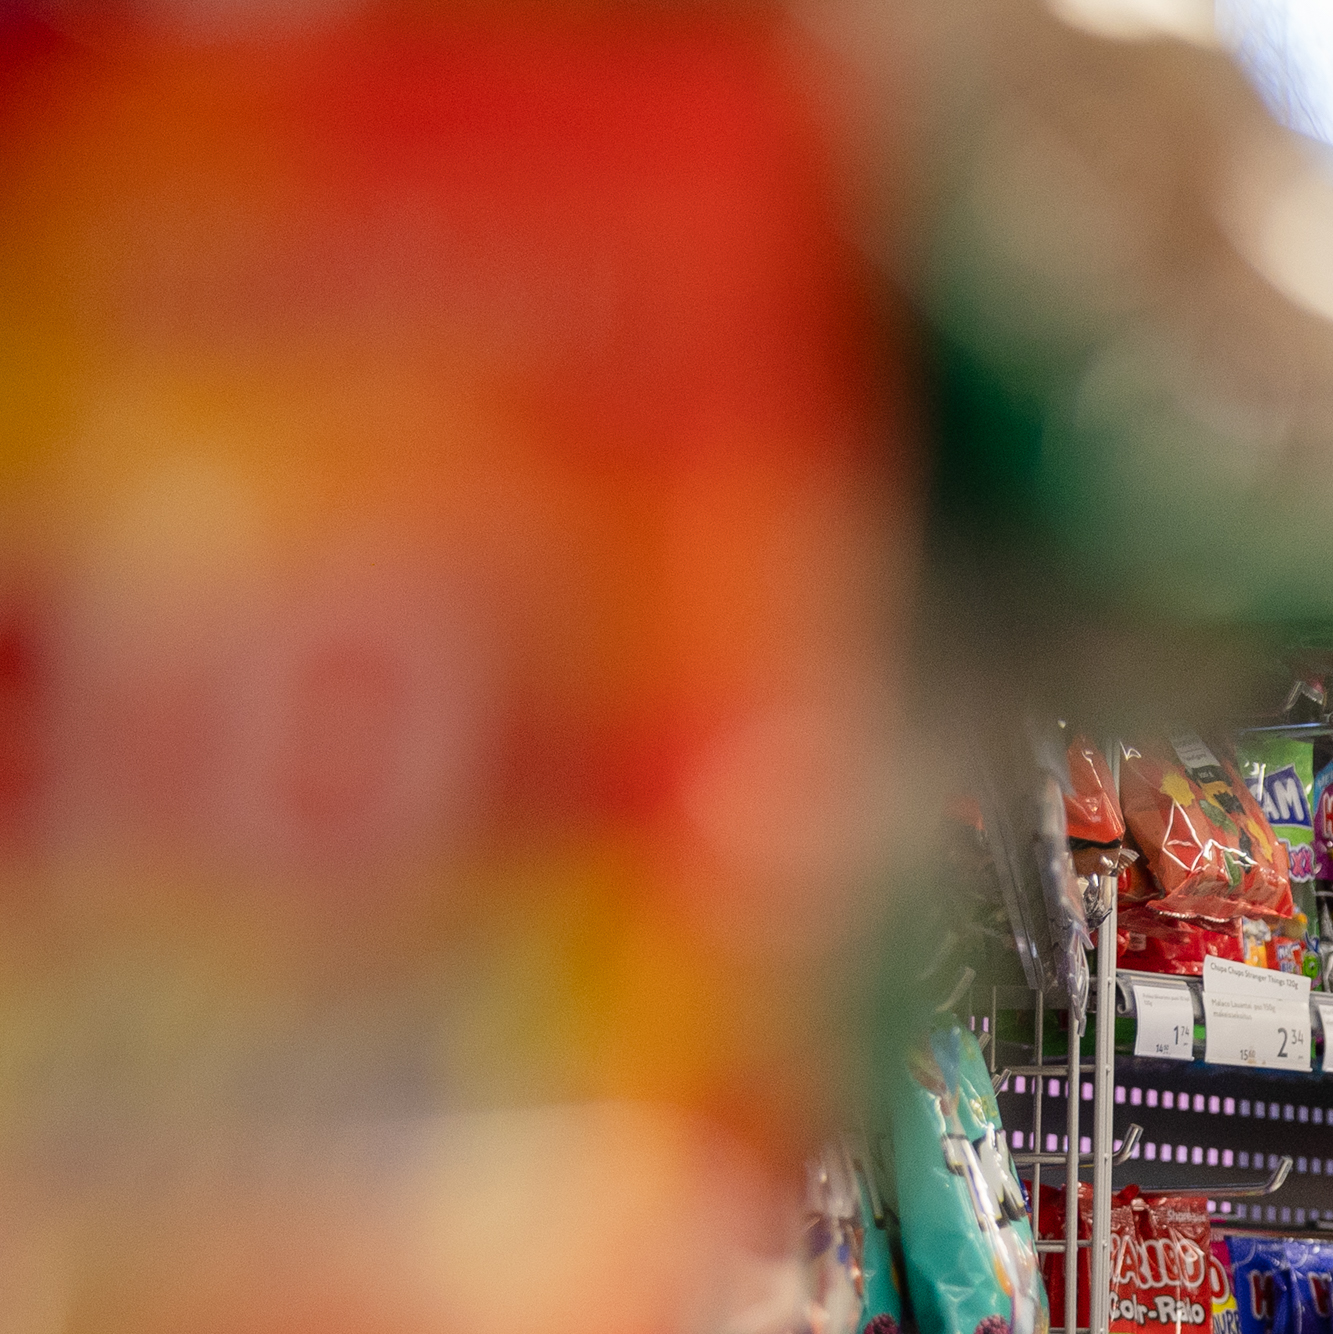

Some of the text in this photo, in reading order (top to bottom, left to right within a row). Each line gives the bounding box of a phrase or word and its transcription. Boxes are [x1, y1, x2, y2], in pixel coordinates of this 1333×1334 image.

[1210, 962, 1299, 990] Chupa Chups Stranger Things 120g
[1277, 1027, 1304, 1058] 2 34
